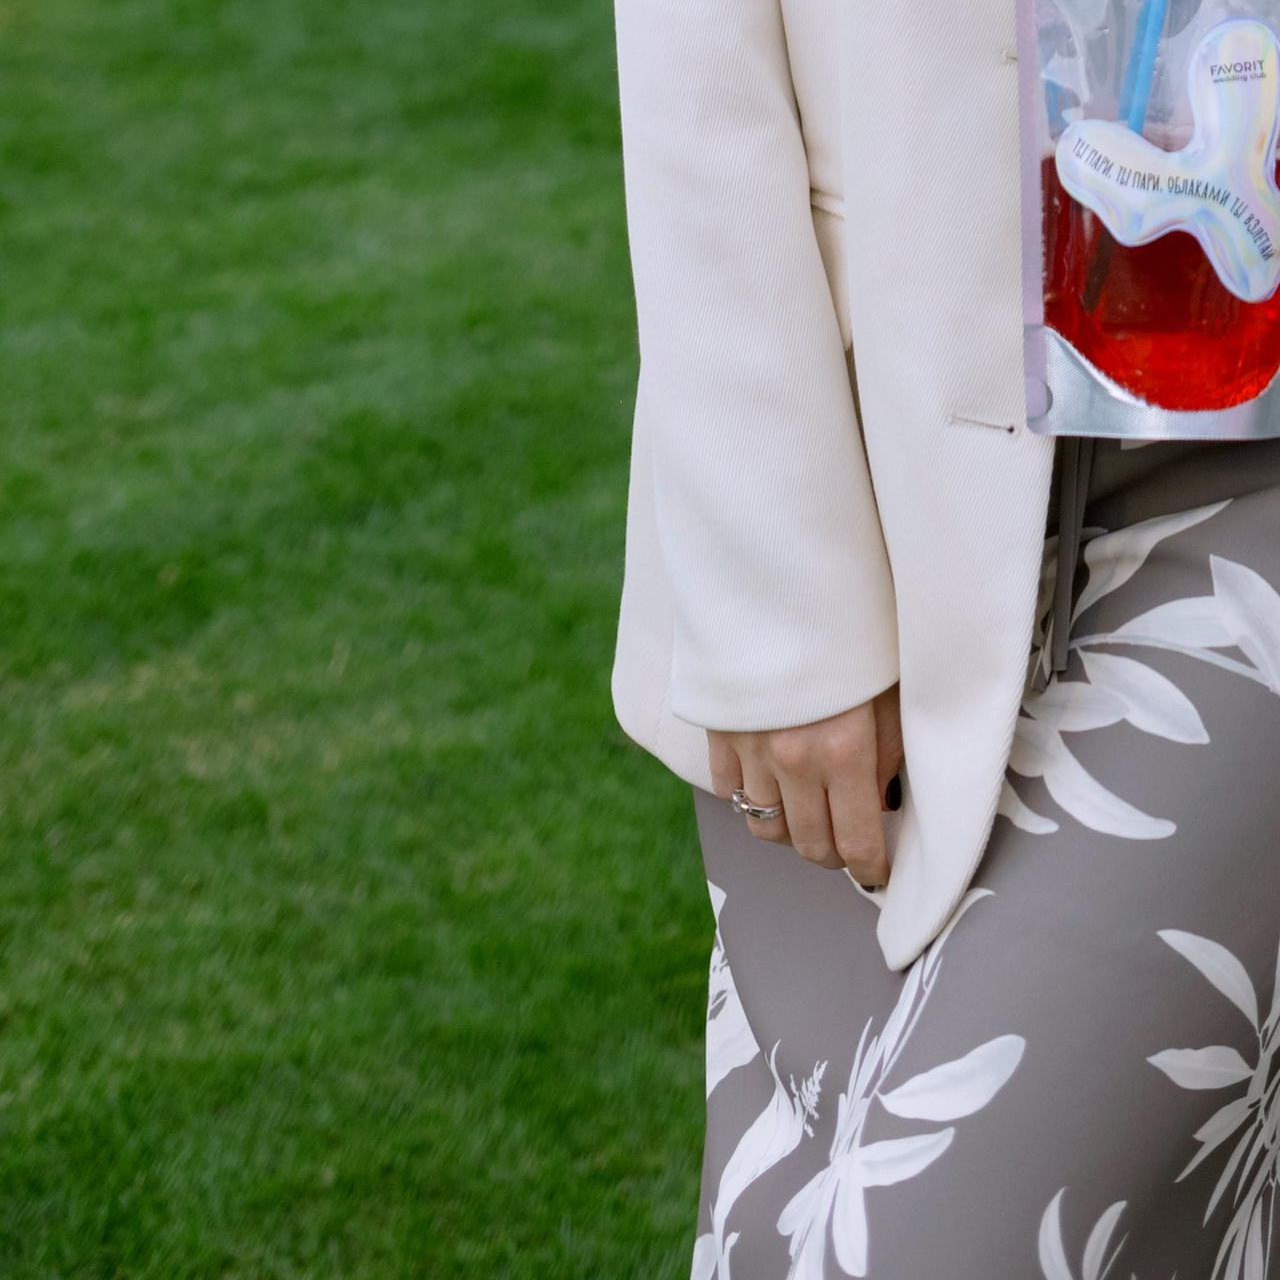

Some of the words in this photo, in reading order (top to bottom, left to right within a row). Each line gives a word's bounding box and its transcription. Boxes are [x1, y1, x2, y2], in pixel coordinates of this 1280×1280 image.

[1210, 60, 1264, 76] FAVORIT
[1213, 73, 1248, 83] wedding
[1072, 137, 1090, 159] ТЫ
[1115, 165, 1132, 186] ТЫ
[1167, 176, 1231, 207] ОБЛАКАМИ
[1230, 196, 1249, 219] ТЫ
[1243, 213, 1278, 261] ВЗЛЕТАЙ
